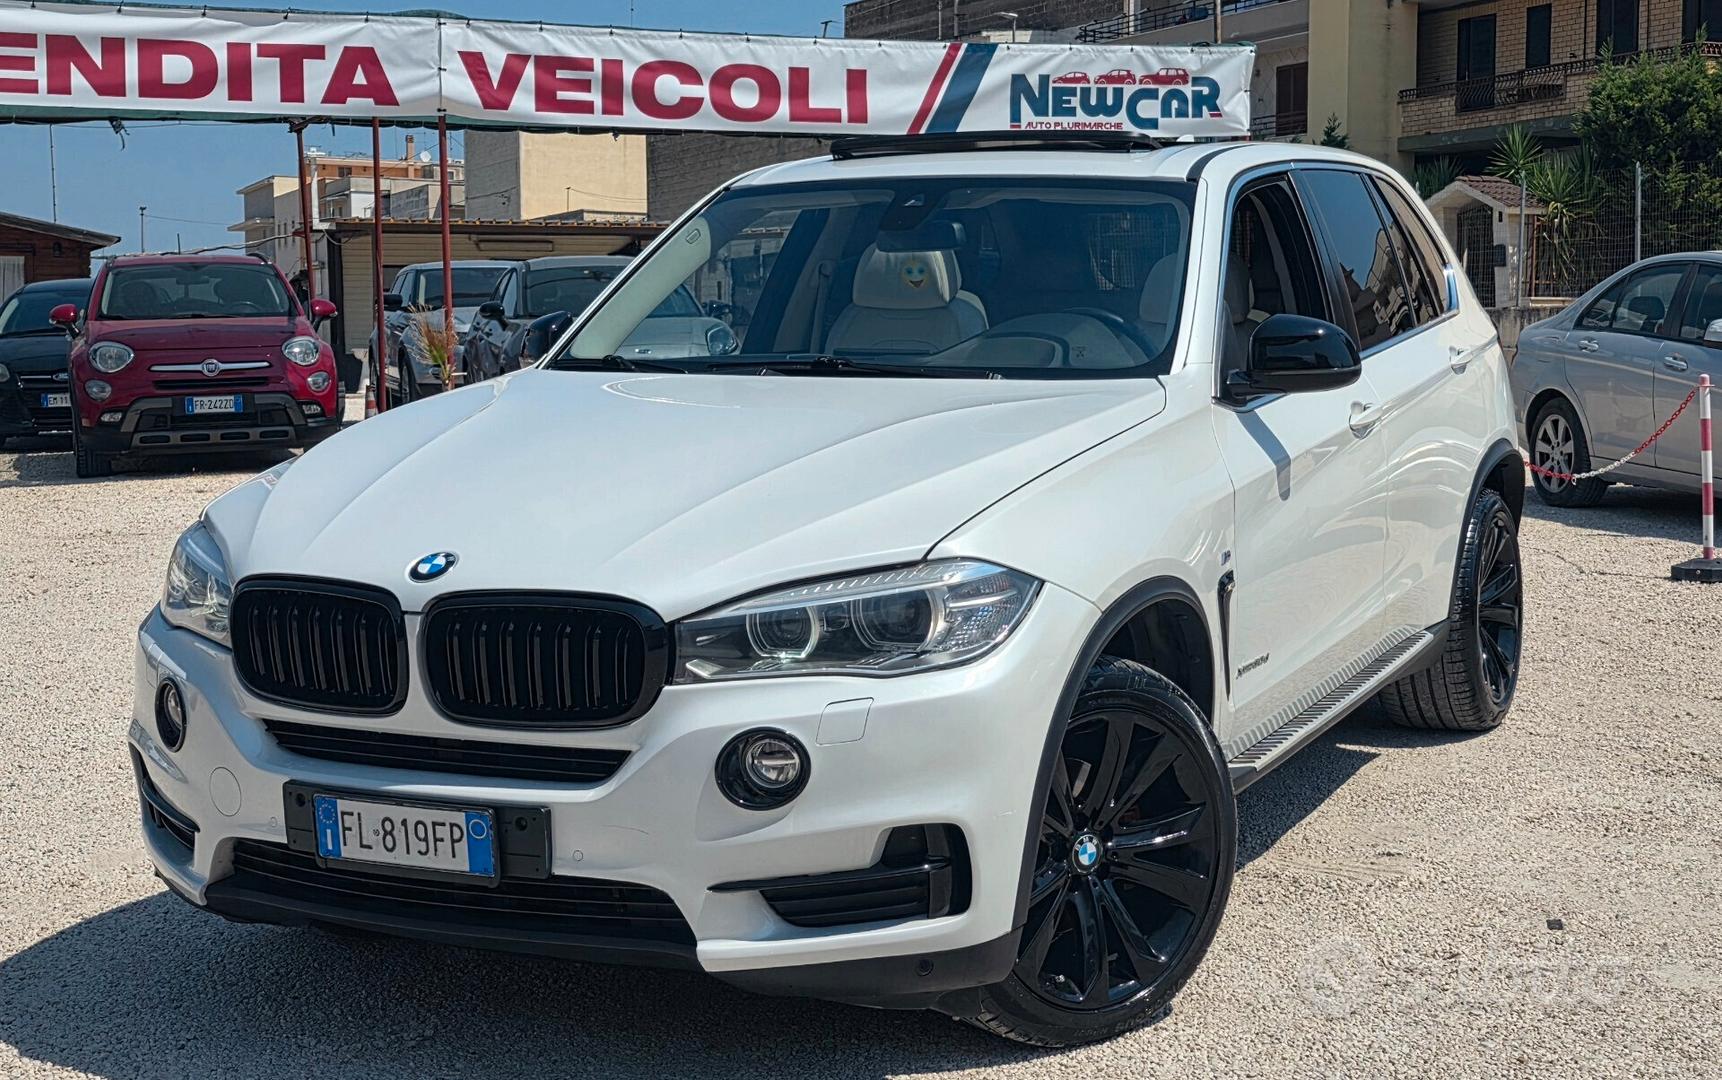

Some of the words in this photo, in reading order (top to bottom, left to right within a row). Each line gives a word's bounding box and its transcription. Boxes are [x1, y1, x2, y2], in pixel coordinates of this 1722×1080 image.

[457, 50, 868, 124] VEICOLI
[1025, 121, 1052, 130] AUTO
[1053, 121, 1124, 131] PLURIMARCHE
